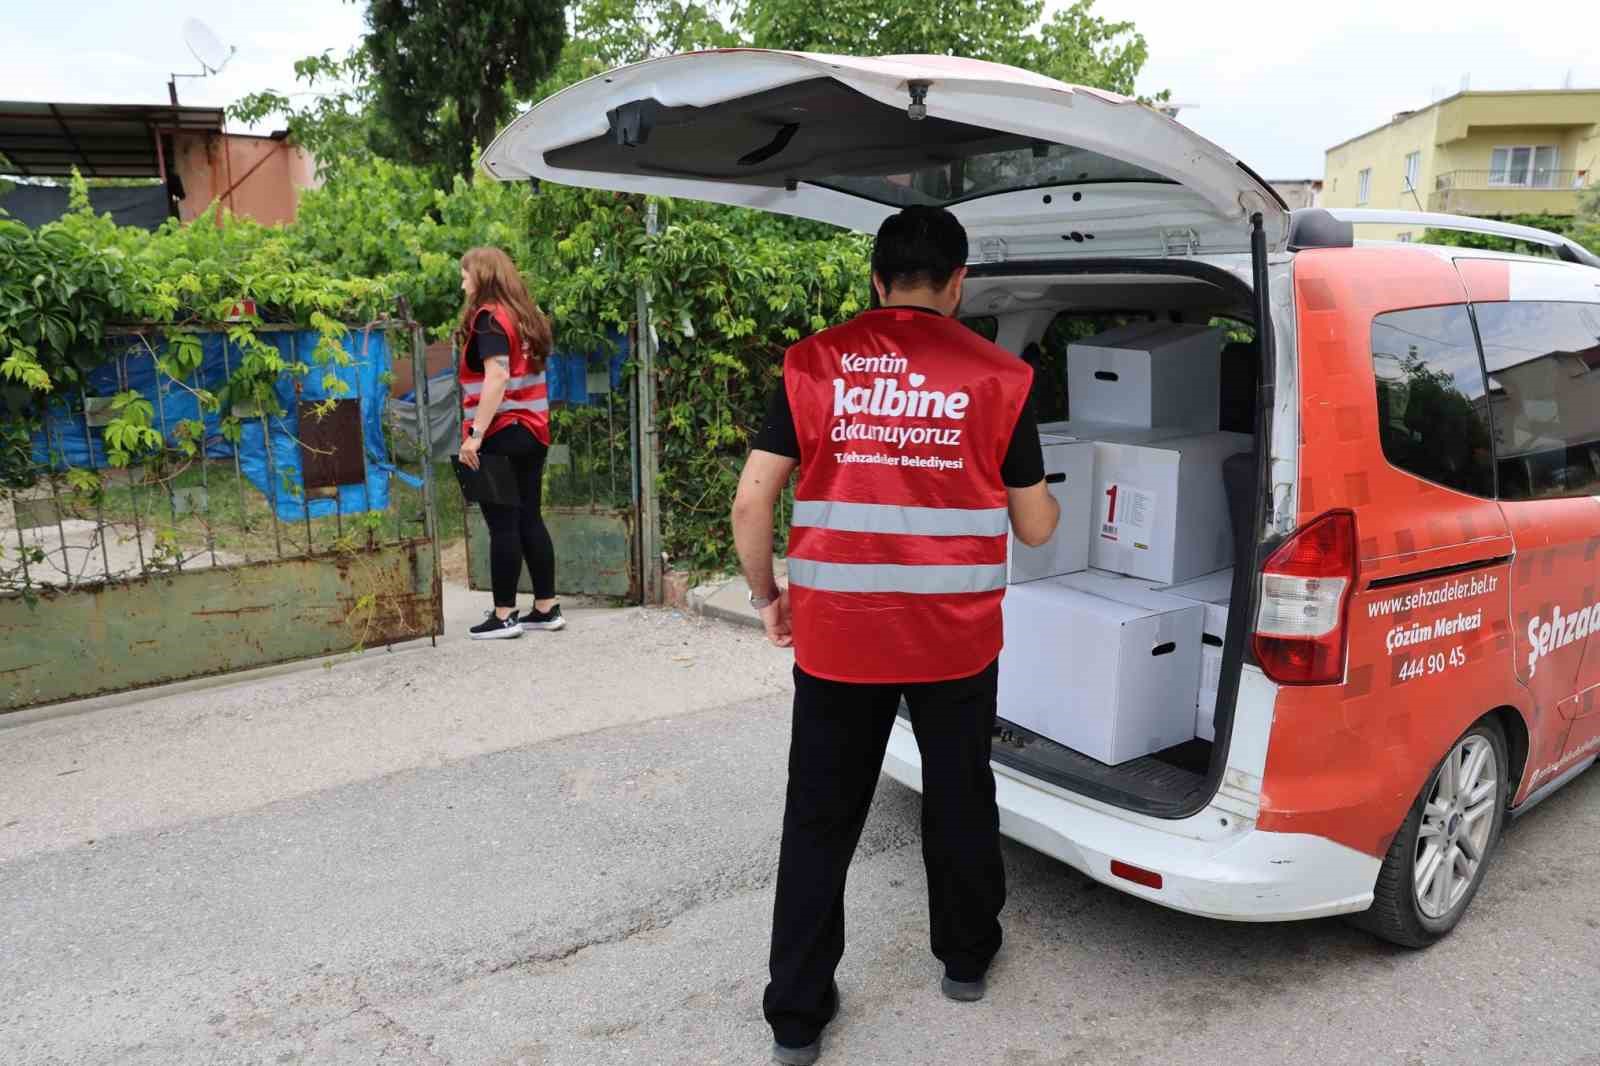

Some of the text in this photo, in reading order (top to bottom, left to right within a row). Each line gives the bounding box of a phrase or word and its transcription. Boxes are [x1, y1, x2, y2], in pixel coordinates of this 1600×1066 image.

[841, 353, 908, 374] Kentin
[833, 373, 970, 420] kalbine
[901, 456, 963, 471] Belediyesi
[1105, 485, 1117, 523] 1
[1368, 574, 1498, 618] www.sehzadeler.bel.tr
[1386, 608, 1482, 655] Çözüm Merkezi
[1398, 645, 1465, 680] 444 90 45
